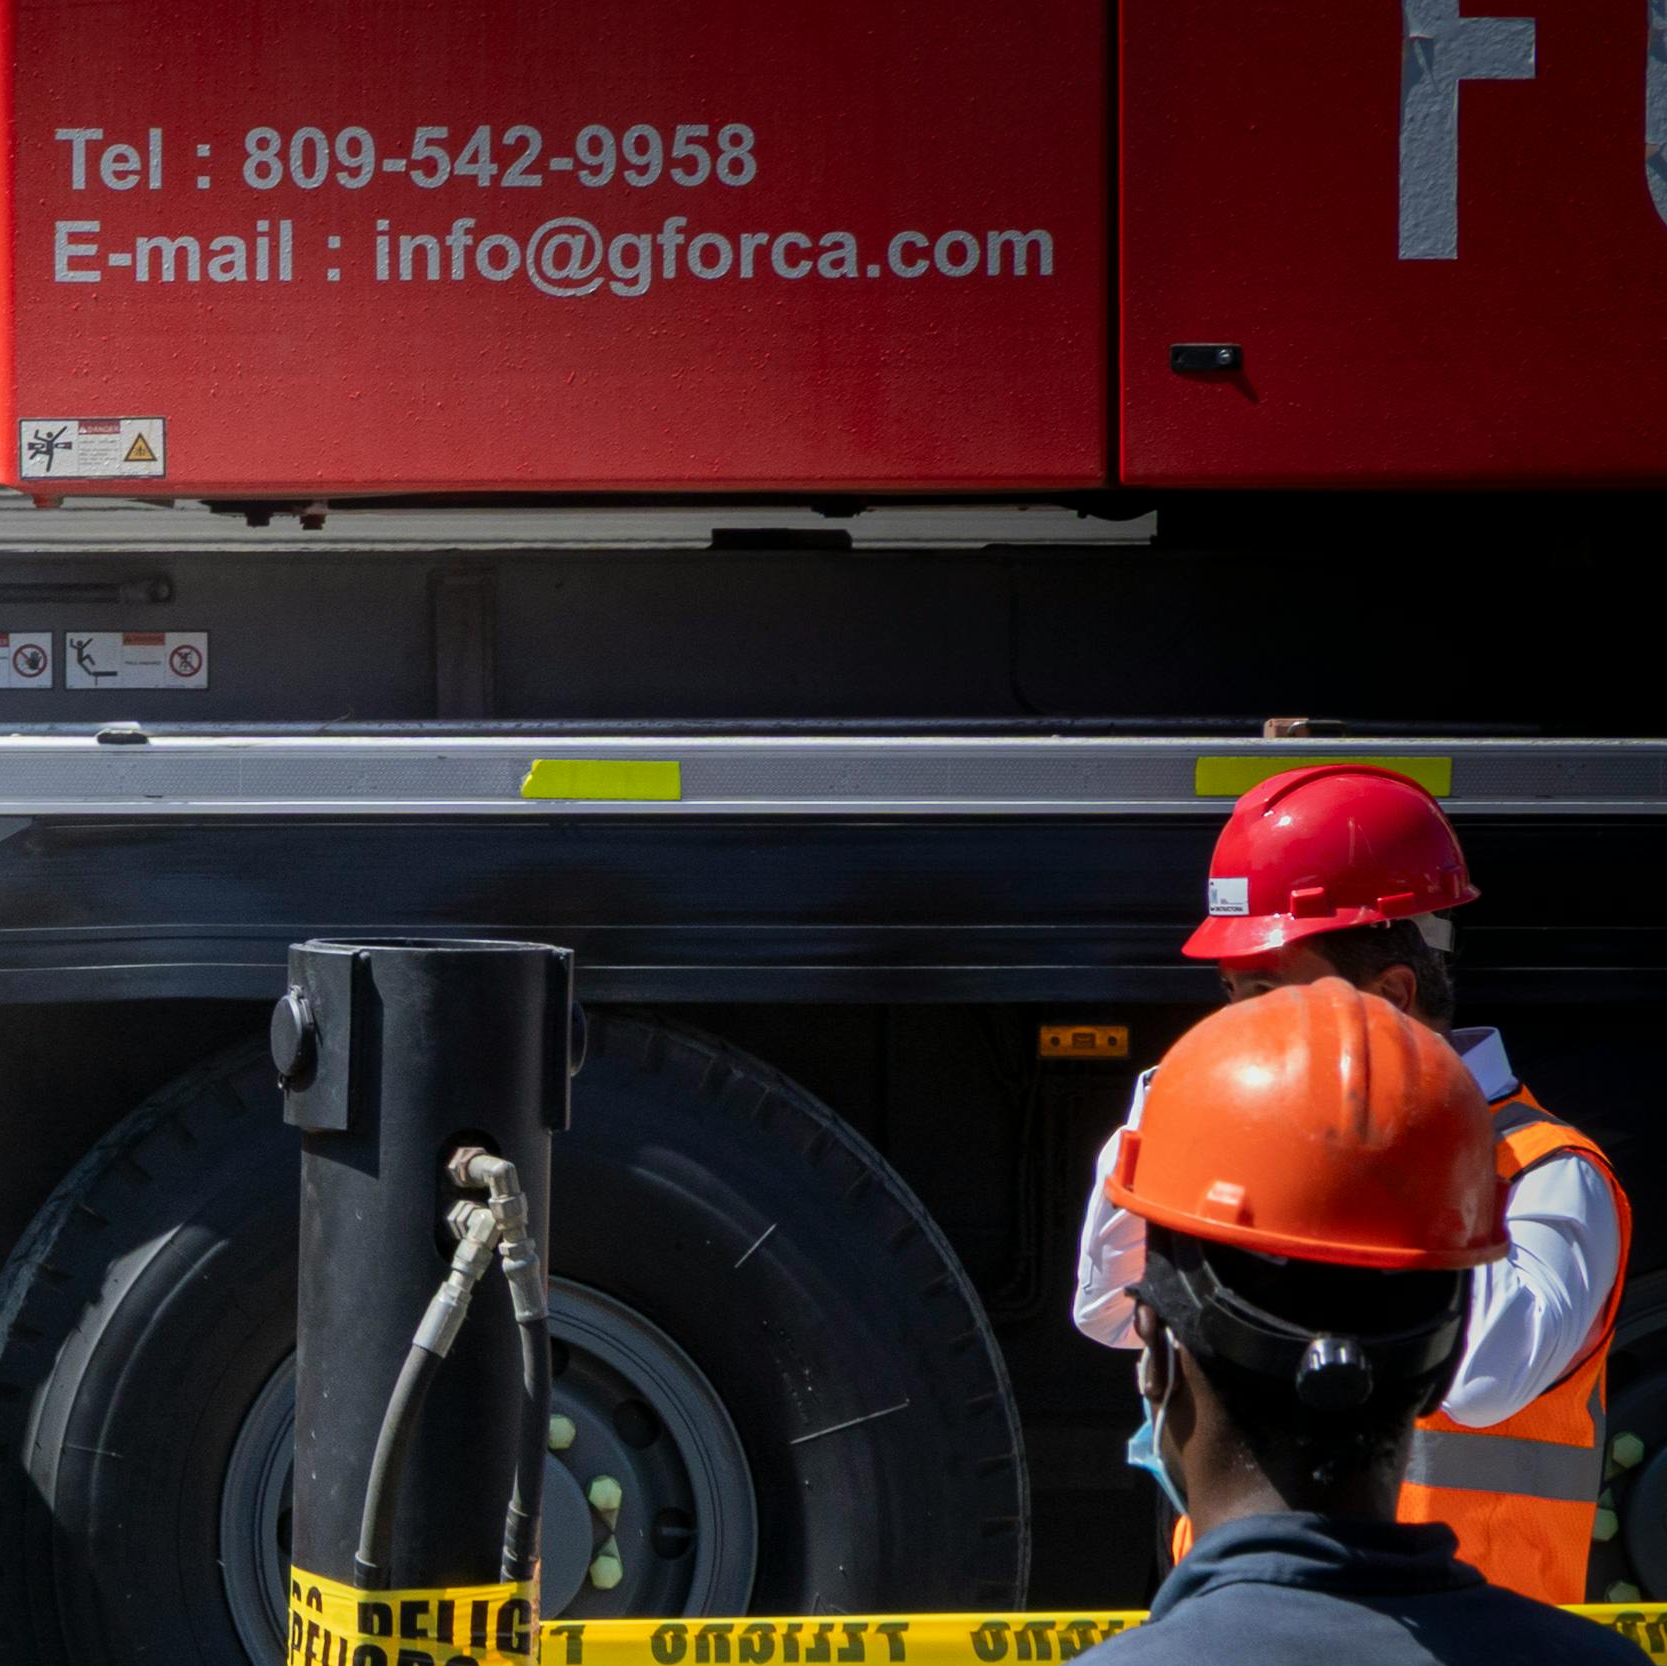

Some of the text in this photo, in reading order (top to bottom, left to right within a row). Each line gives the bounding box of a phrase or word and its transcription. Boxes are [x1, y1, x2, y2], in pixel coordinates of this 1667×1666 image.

[54, 127, 162, 190] Tel
[242, 123, 757, 190] 809-542-9958
[53, 219, 293, 283] E-mail
[375, 216, 1053, 297] info@gforca.com
